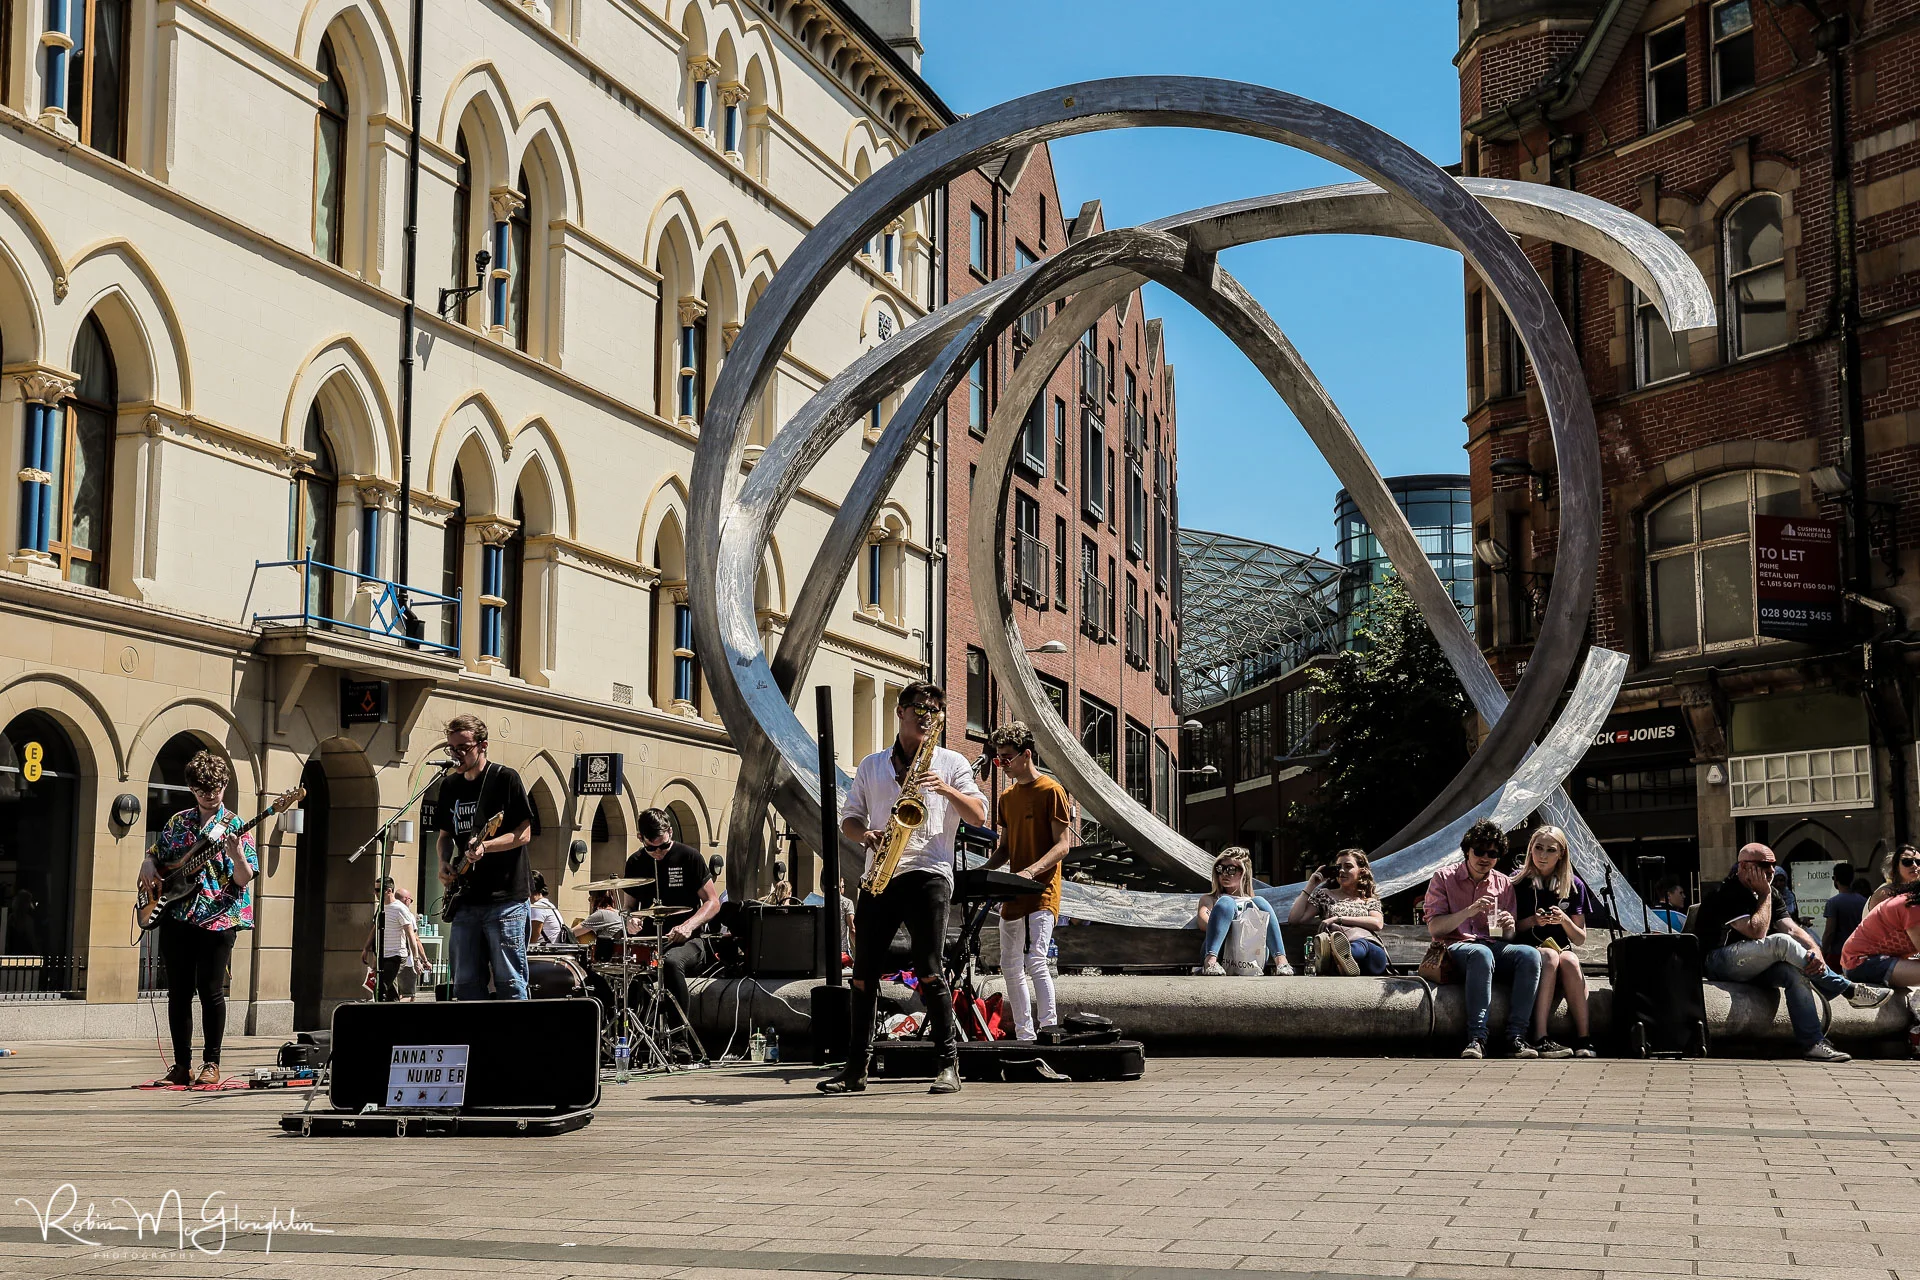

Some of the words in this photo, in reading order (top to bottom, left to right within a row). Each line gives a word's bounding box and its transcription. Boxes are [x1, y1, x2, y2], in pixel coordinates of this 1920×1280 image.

[1759, 547, 1778, 560] TO
[1781, 549, 1806, 562] LET
[1761, 608, 1780, 618] 028
[1782, 609, 1807, 619] 9023
[1809, 610, 1832, 621] 3455
[1629, 725, 1676, 742] JONES
[392, 1049, 444, 1064] ANNA'S
